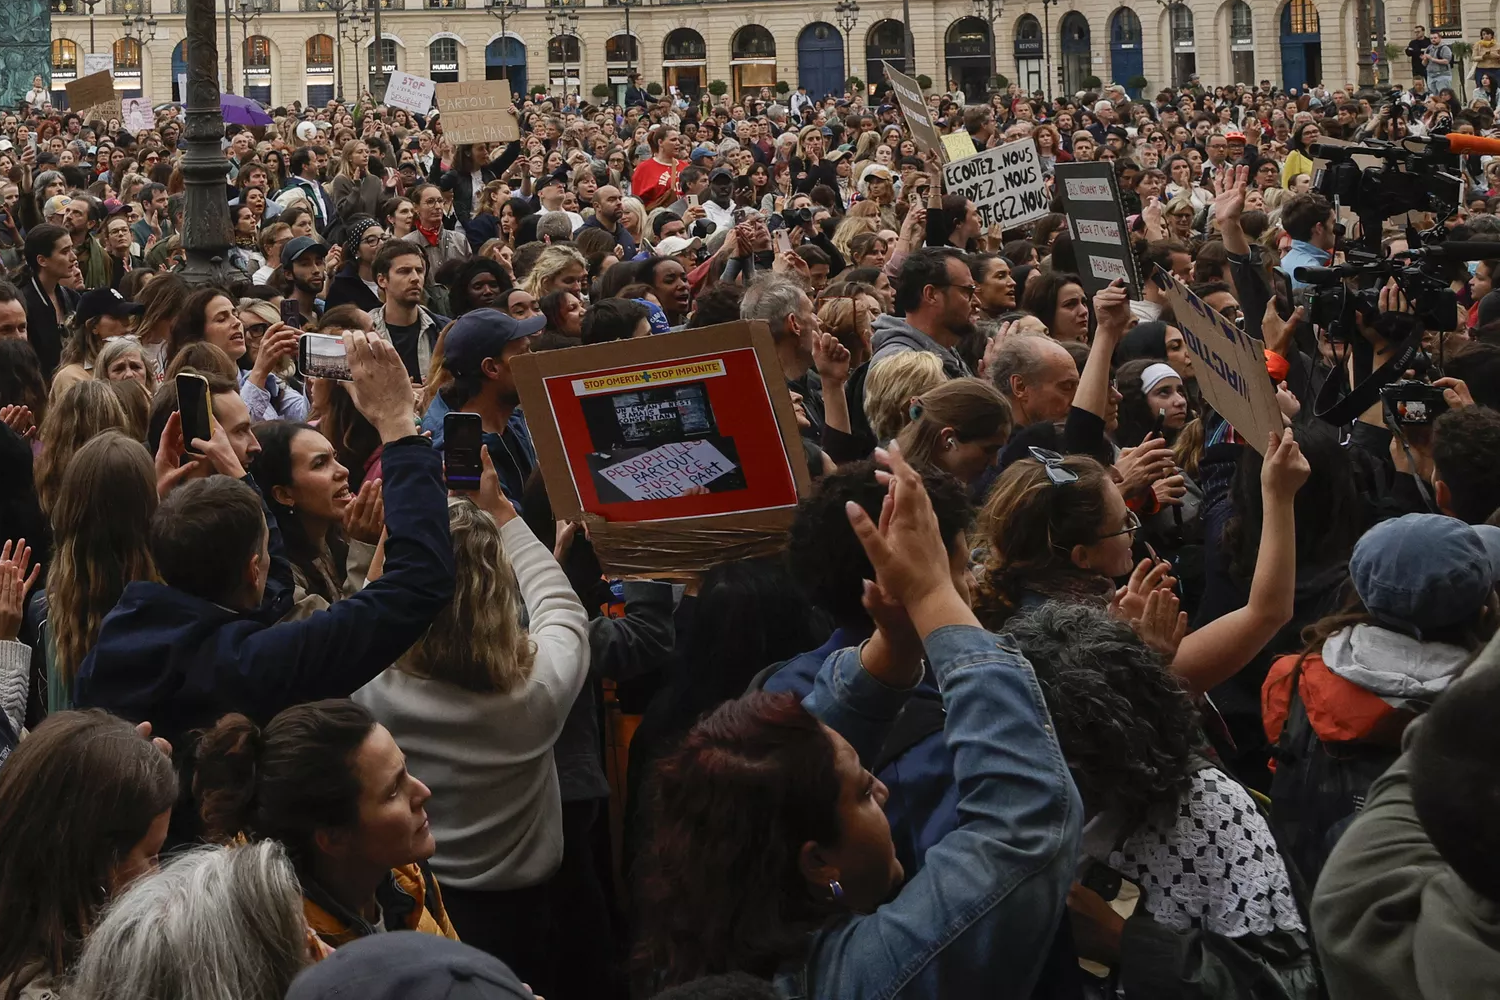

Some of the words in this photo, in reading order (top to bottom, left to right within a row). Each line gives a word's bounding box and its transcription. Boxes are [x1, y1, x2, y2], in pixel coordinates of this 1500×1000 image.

[402, 77, 426, 90] STOP
[438, 96, 496, 110] PARTOUT
[445, 129, 478, 142] NULLE
[483, 126, 513, 140] PART
[1393, 346, 1414, 369] Canon
[584, 379, 605, 389] STOP
[652, 370, 674, 379] STOP
[622, 410, 655, 418] JAMAIS
[631, 451, 694, 483] PARTOUT
[635, 460, 707, 493] JUSTICE
[688, 461, 724, 485] PART
